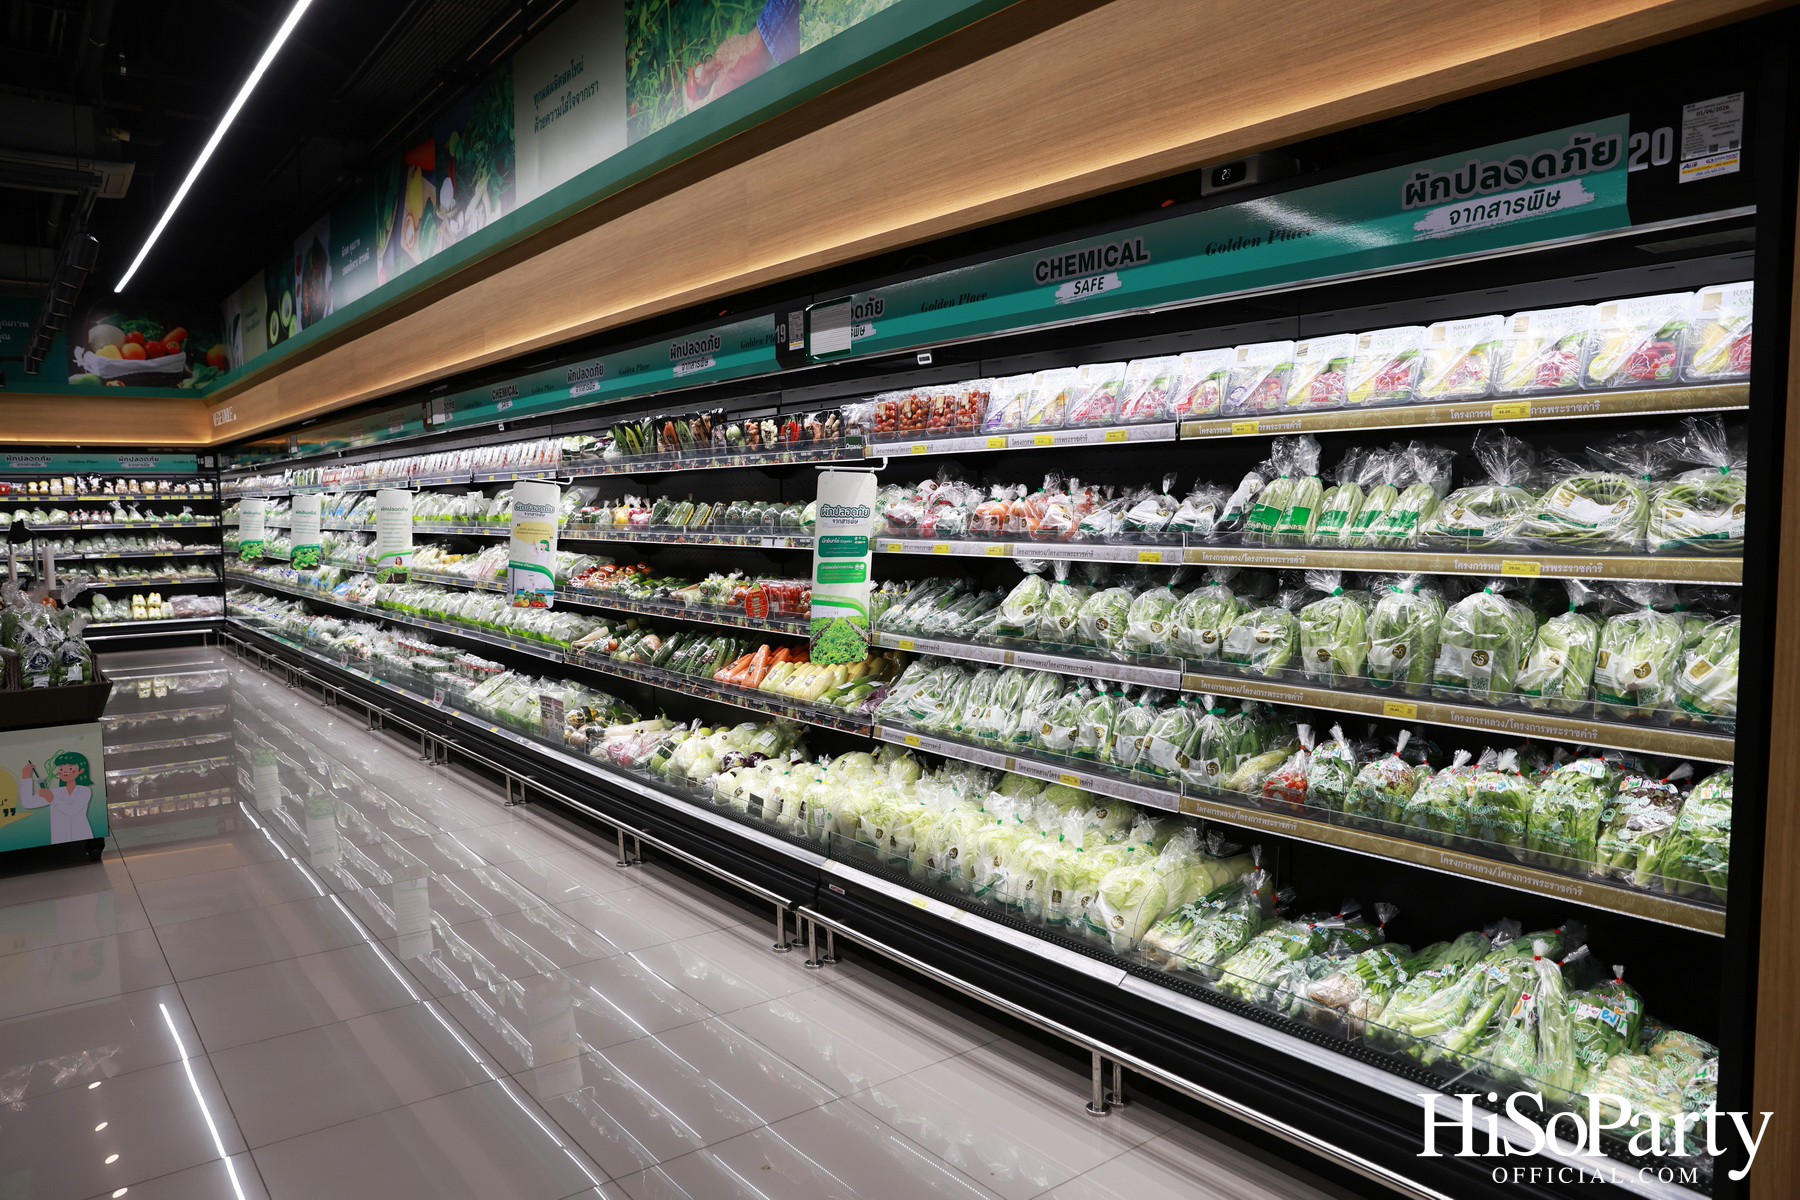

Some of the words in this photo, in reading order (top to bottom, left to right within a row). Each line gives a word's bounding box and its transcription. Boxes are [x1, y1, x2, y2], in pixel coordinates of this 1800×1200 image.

[1628, 126, 1674, 172] 20
[1405, 136, 1618, 206] ผักปลอดภัย
[1449, 188, 1561, 226] จากสารพิษ
[1205, 234, 1260, 257] Golden
[1036, 239, 1148, 282] CHEMICAL
[1074, 276, 1105, 296] SAFE
[920, 301, 950, 313] Golden
[958, 292, 988, 307] Place
[669, 334, 721, 361] ผักปลอดภัย
[740, 337, 763, 349] Golden
[566, 362, 604, 384] ผักปลอดภัย
[682, 357, 709, 372] จากสารพิษ
[492, 383, 518, 401] CHEMICAL
[514, 502, 555, 513] ผักปลอดภัย
[820, 504, 870, 518] ผักปลอดภัย
[1202, 552, 1306, 564] โครงการหลวง/โครงการพระราชดำริ
[1200, 680, 1304, 701] โครงการหลวง/โครงการพระราชดำริ
[1450, 710, 1598, 740] โครงการหลวง/โครงการพระราชดำริ
[1196, 804, 1298, 830] โครงการหลวง/โครงการพระราชดำริ
[1440, 854, 1584, 896] โครงการหลวง/โครงการพระราชดำริ
